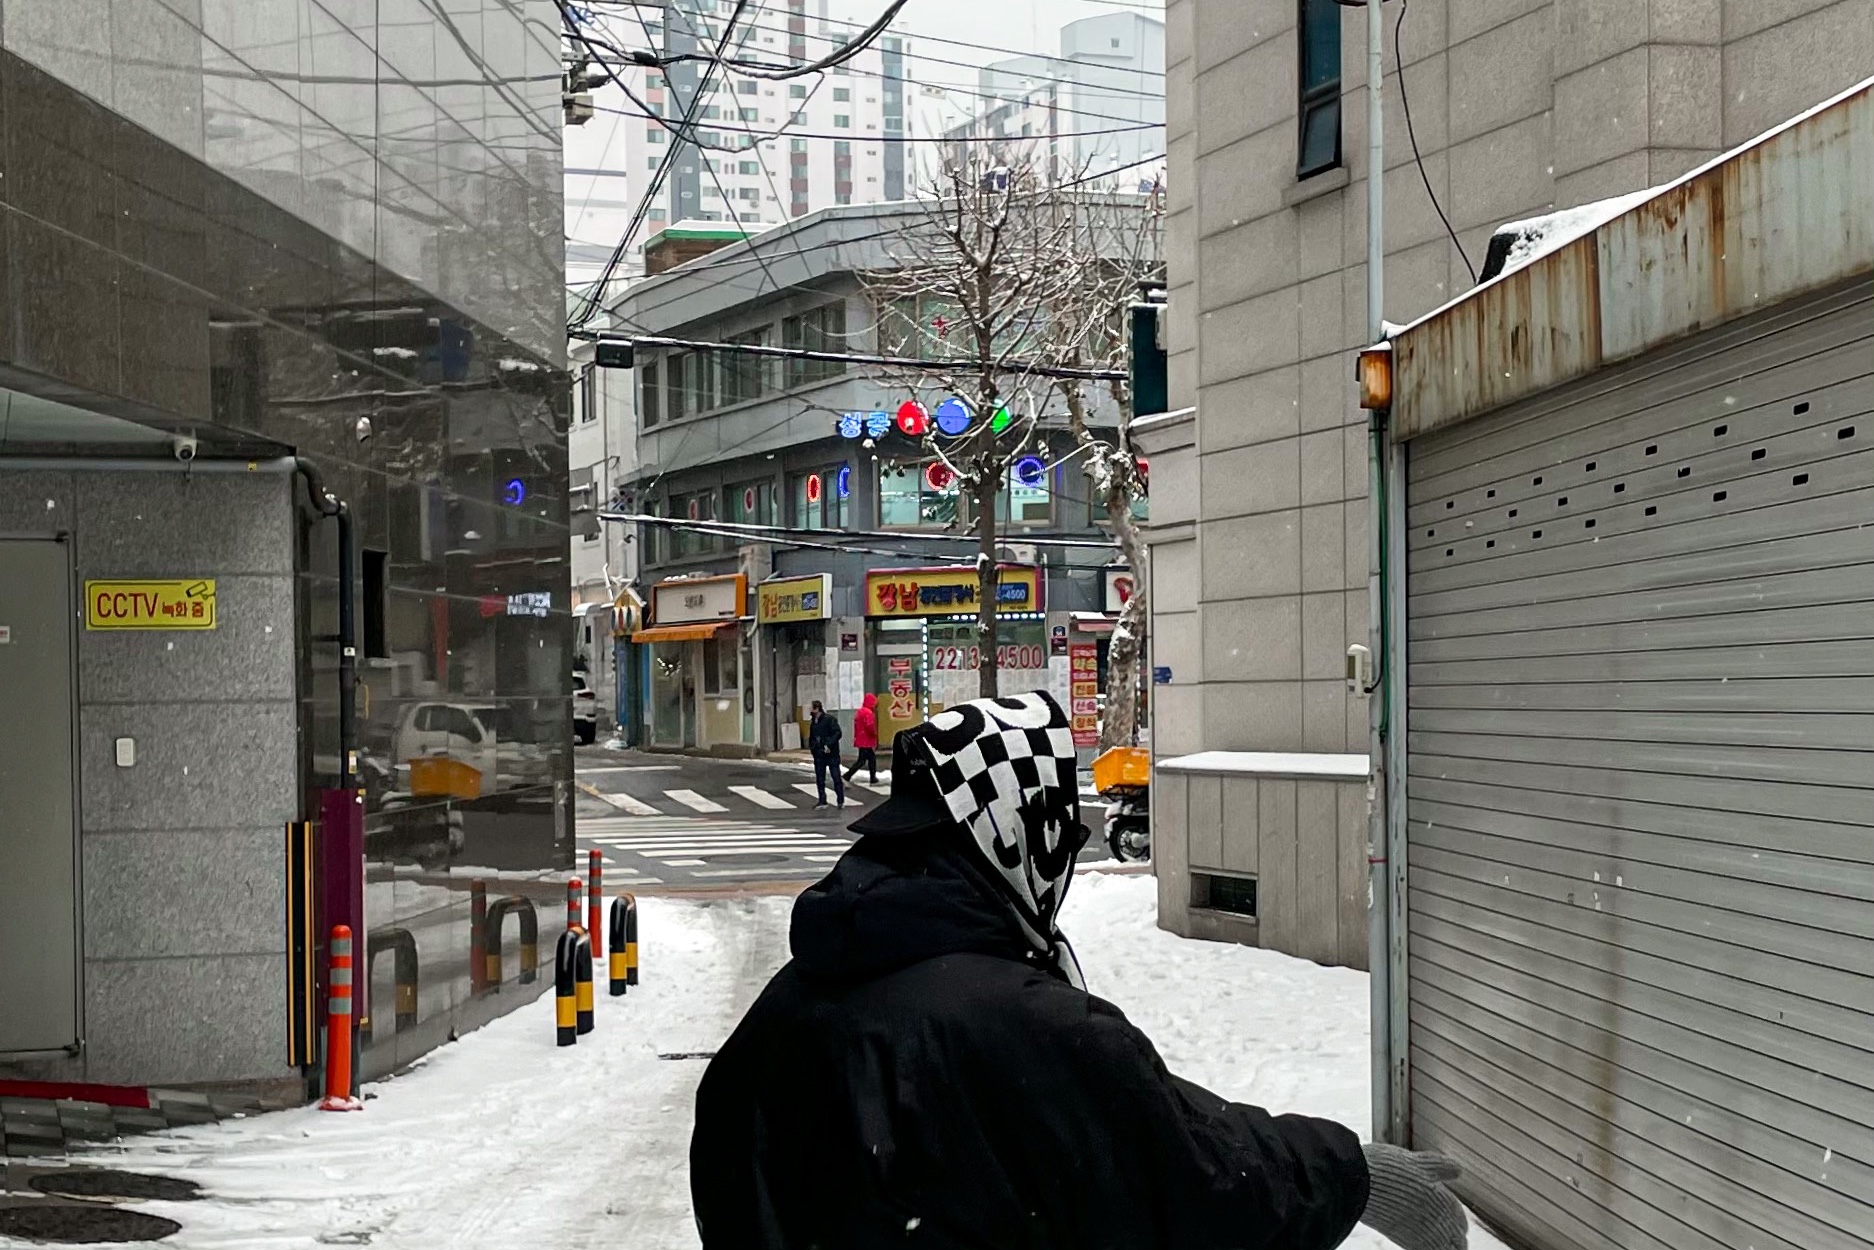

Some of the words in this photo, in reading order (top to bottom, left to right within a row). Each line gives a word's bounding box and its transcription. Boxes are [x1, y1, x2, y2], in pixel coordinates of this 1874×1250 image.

[97, 592, 158, 618] CCTV
[191, 601, 204, 618] 중
[935, 645, 981, 670] 2213
[996, 644, 1044, 669] 4500
[888, 658, 914, 720] 부동산
